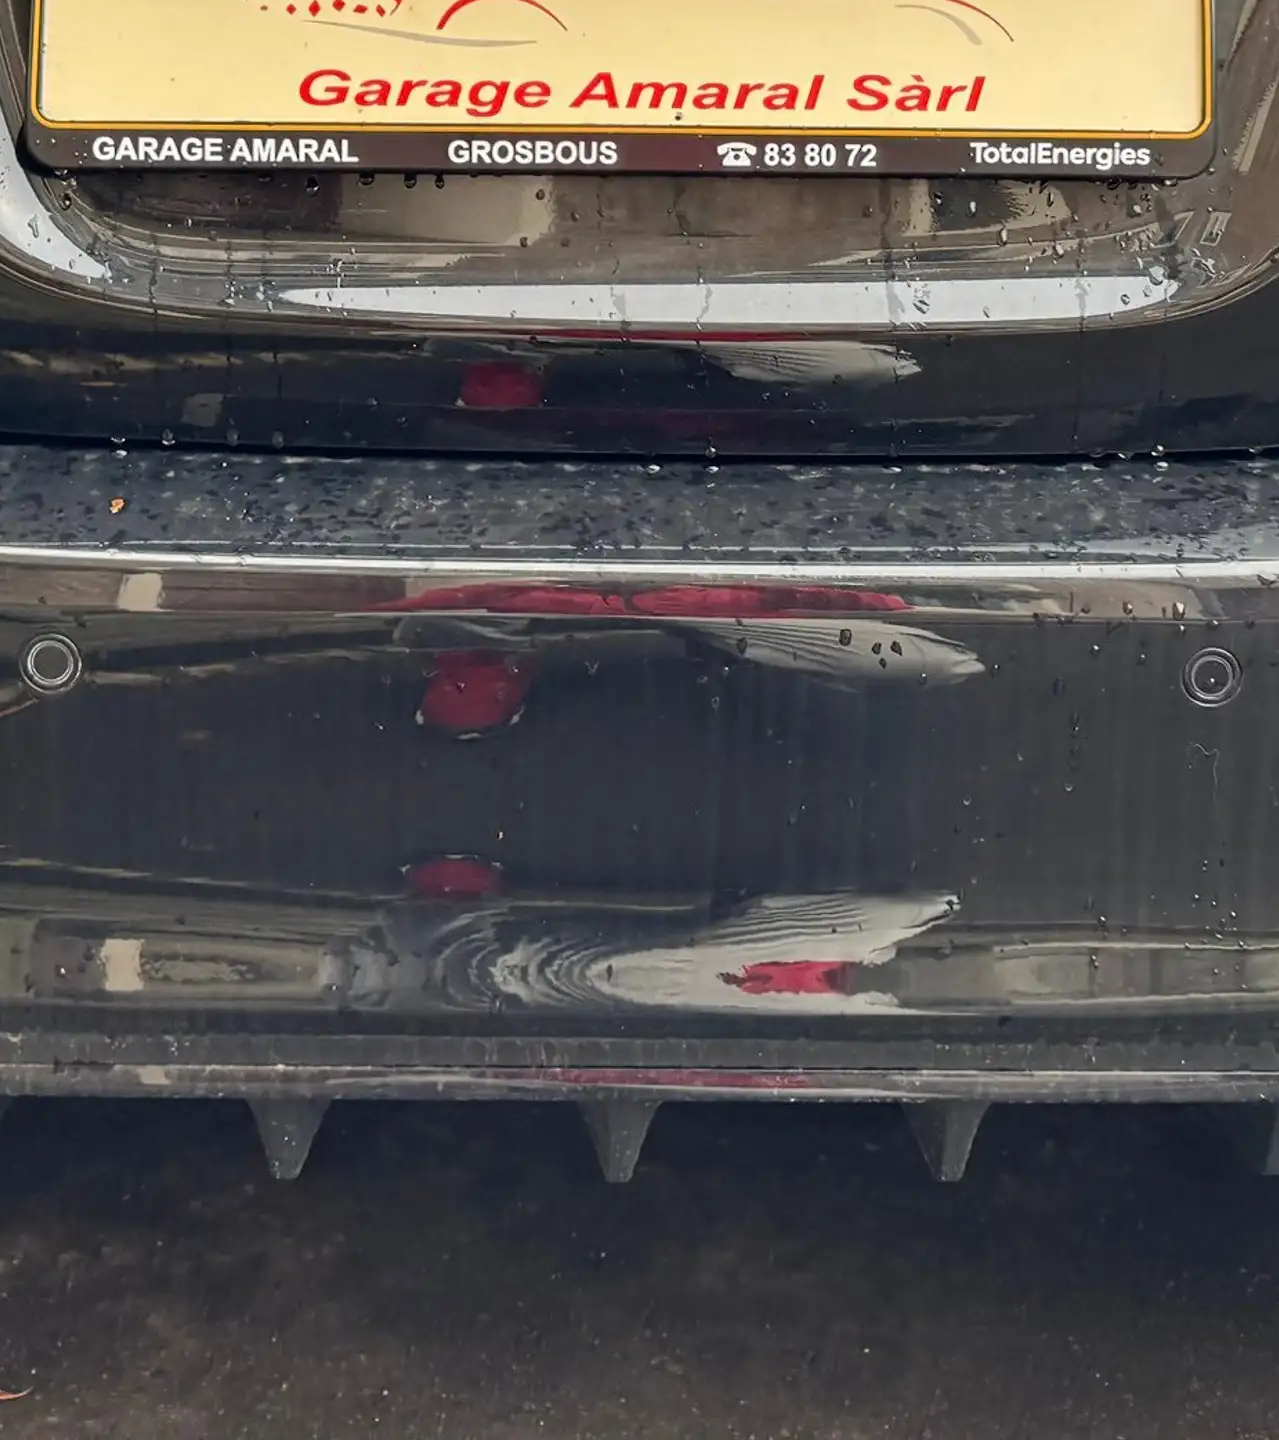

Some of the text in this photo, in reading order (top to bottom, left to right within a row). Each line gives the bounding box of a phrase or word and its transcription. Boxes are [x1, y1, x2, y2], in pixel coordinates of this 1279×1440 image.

[297, 68, 987, 118] Garage Amaral Sàrl
[92, 136, 359, 163] GARAGE AMARAL
[447, 139, 618, 165] GROSBOUS
[763, 142, 877, 167] 83 80 72
[969, 142, 1151, 171] TotalEnergies
